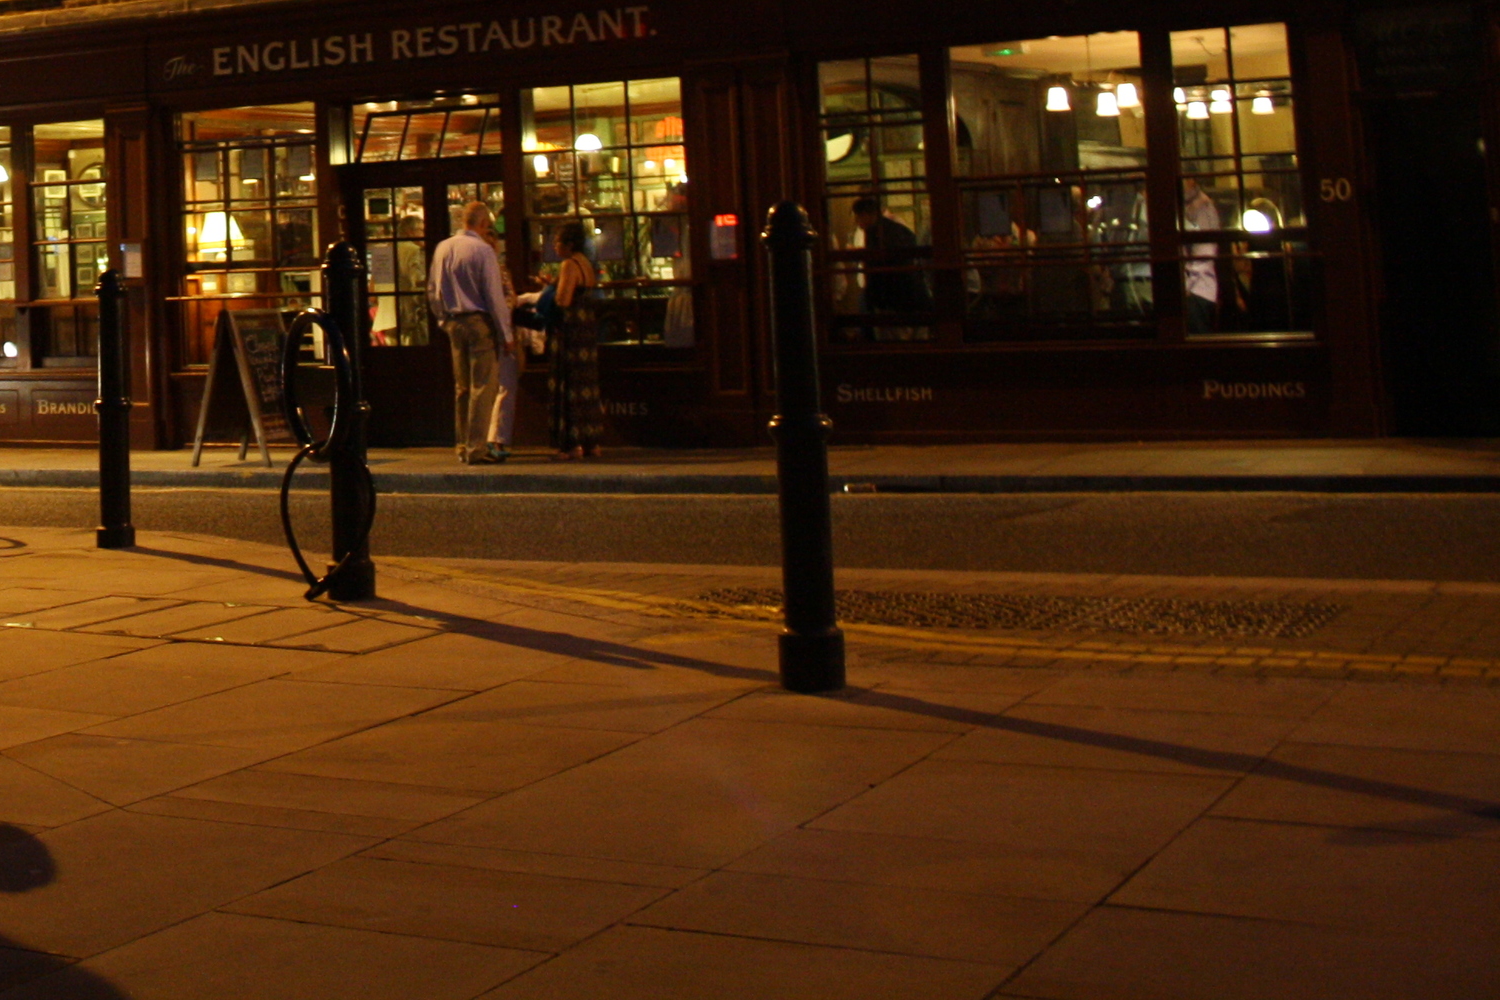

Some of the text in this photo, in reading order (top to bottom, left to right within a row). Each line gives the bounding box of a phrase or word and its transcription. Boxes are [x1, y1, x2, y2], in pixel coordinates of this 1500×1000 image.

[162, 5, 658, 81] The ENGLISH RESTAURANT.
[1320, 177, 1351, 202] 50
[836, 383, 933, 403] SHELLFISH
[1202, 379, 1306, 400] PUDDINGS
[37, 400, 100, 415] BRANDIE
